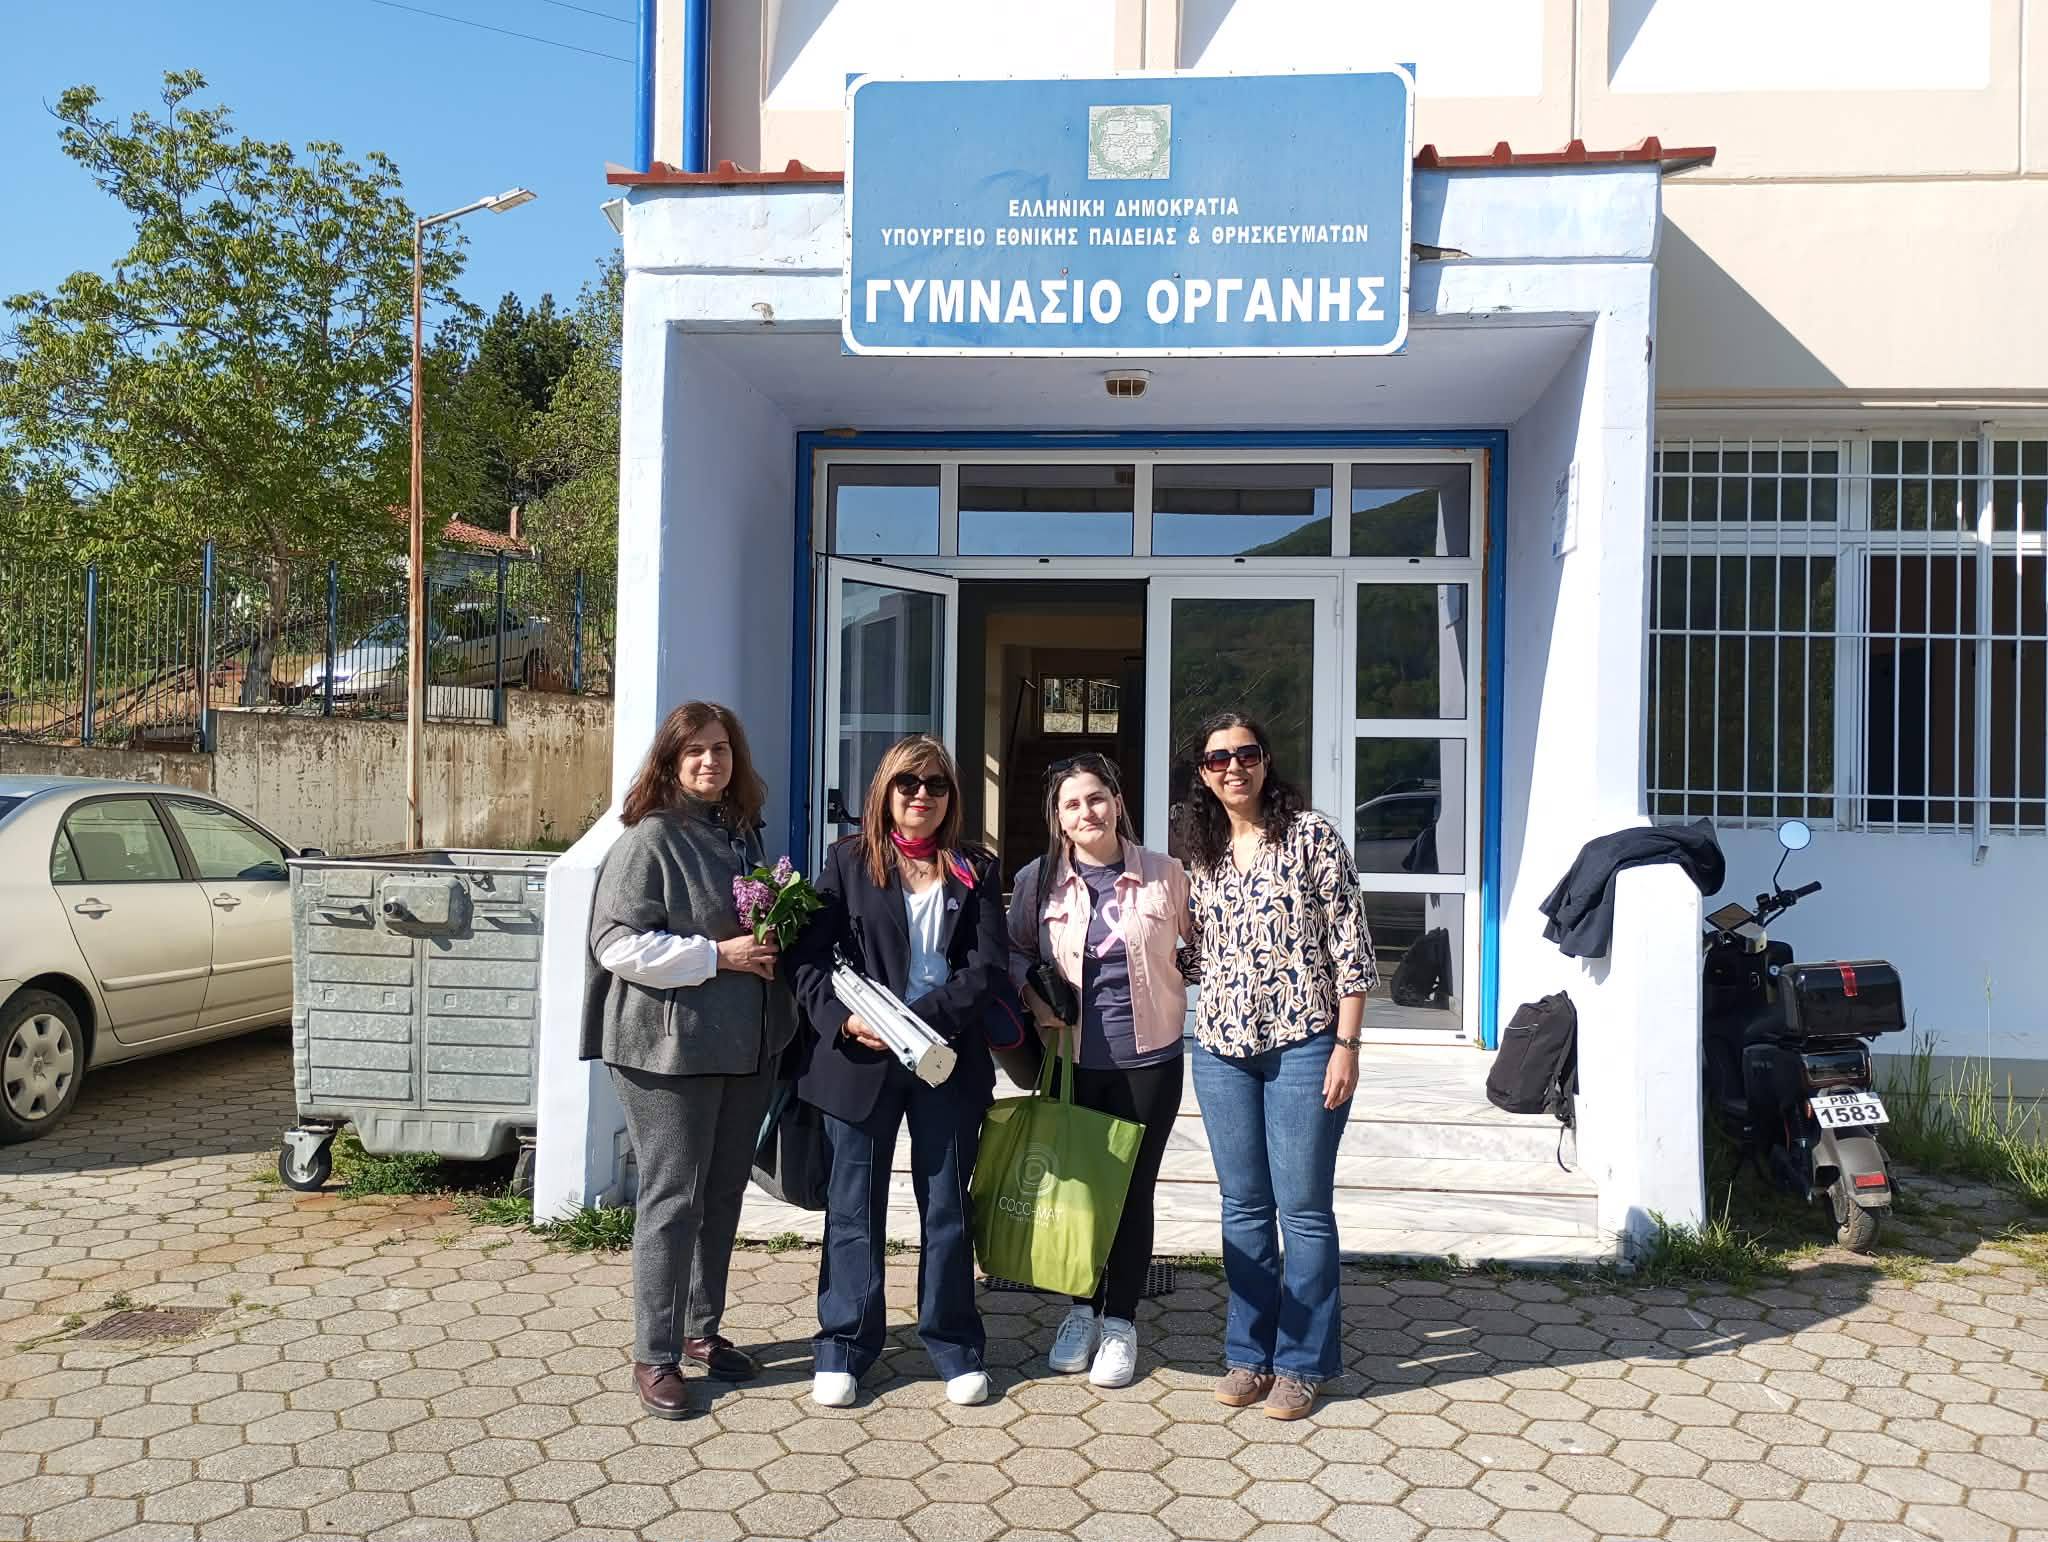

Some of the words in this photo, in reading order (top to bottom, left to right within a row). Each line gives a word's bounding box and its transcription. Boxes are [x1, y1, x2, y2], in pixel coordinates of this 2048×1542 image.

[1008, 199, 1105, 217] ΕΛΛΗΝΙΚΗ
[1114, 197, 1239, 217] ΔΗΜΟΚΡΑΤΙΑ
[880, 228, 985, 246] ΥΠΟΥΡΓΕΙΟ
[996, 227, 1078, 246] ΕΘΝΙΚΗΣ
[1089, 227, 1177, 246] ΠΑΙΔΕΙΑΣ
[1187, 227, 1201, 245] &
[1211, 224, 1369, 245] ΘΡΗΣΚΕΥΜΑΤΩΝ
[865, 278, 1122, 324] ΓΥΜΝΑΣΙΟ
[1146, 276, 1386, 325] ΟΡΓΑΝΗΣ
[1821, 1104, 1881, 1124] 1583
[999, 1196, 1063, 1221] COCO-MAT
